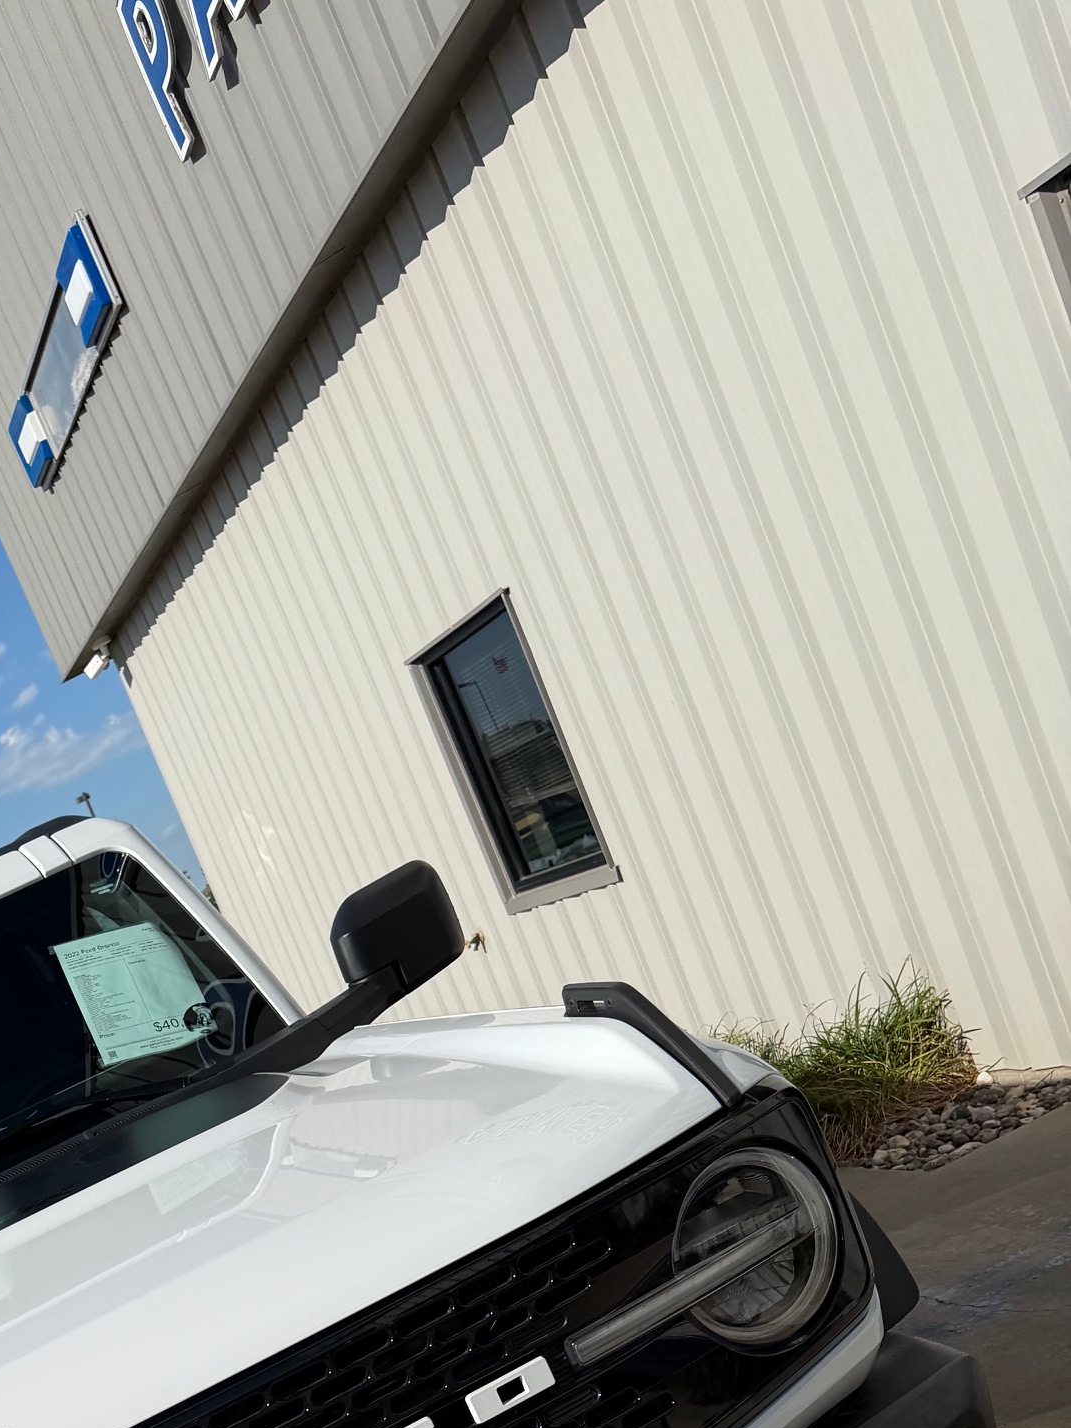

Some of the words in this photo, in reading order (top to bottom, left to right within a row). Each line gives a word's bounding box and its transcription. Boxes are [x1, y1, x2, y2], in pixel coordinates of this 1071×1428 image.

[64, 951, 80, 960] 2022
[81, 947, 96, 955] Ford
[97, 941, 120, 951] Bronco
[153, 1018, 186, 1033] $40,
